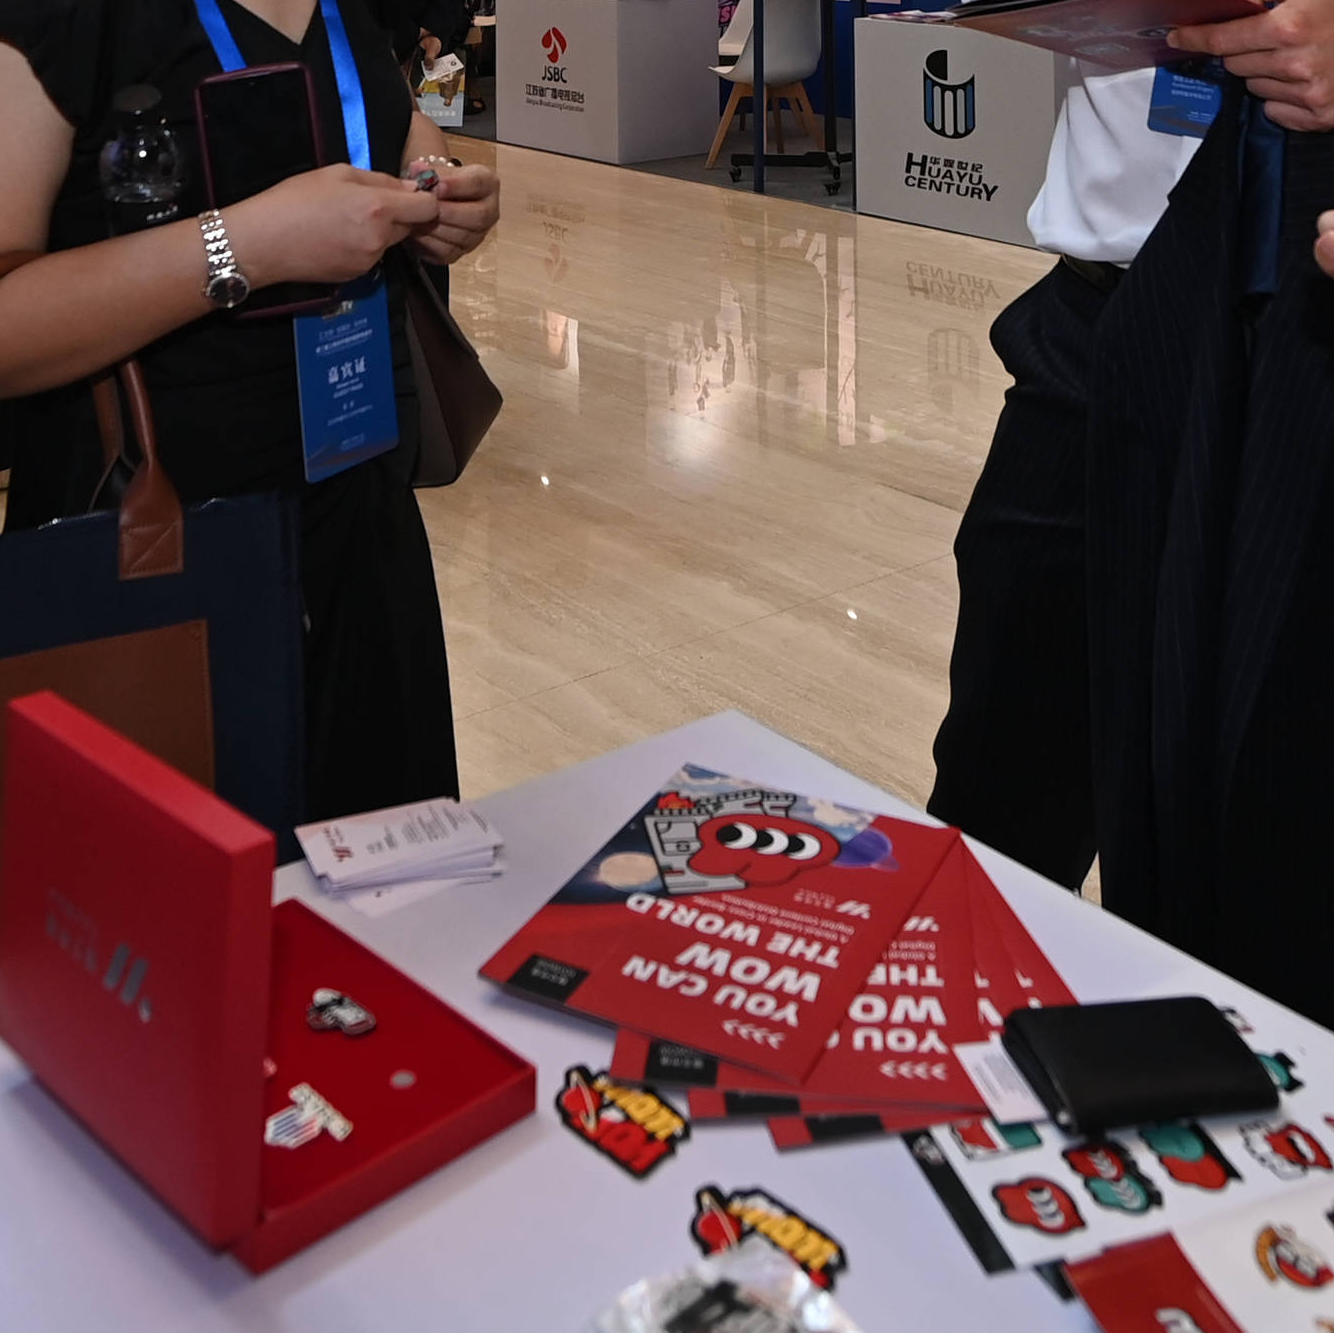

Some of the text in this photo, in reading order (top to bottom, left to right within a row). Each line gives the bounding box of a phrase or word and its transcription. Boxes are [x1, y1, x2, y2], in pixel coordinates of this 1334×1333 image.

[542, 66, 567, 83] JSBC
[905, 152, 983, 186] HUAYU
[904, 175, 999, 202] CENTURY
[626, 892, 760, 947] WORLD
[766, 931, 841, 969] THE
[674, 941, 821, 1003] WOW
[621, 955, 799, 1027] YOU CAN
[848, 994, 947, 1027] WO
[852, 1027, 948, 1055] YOU
